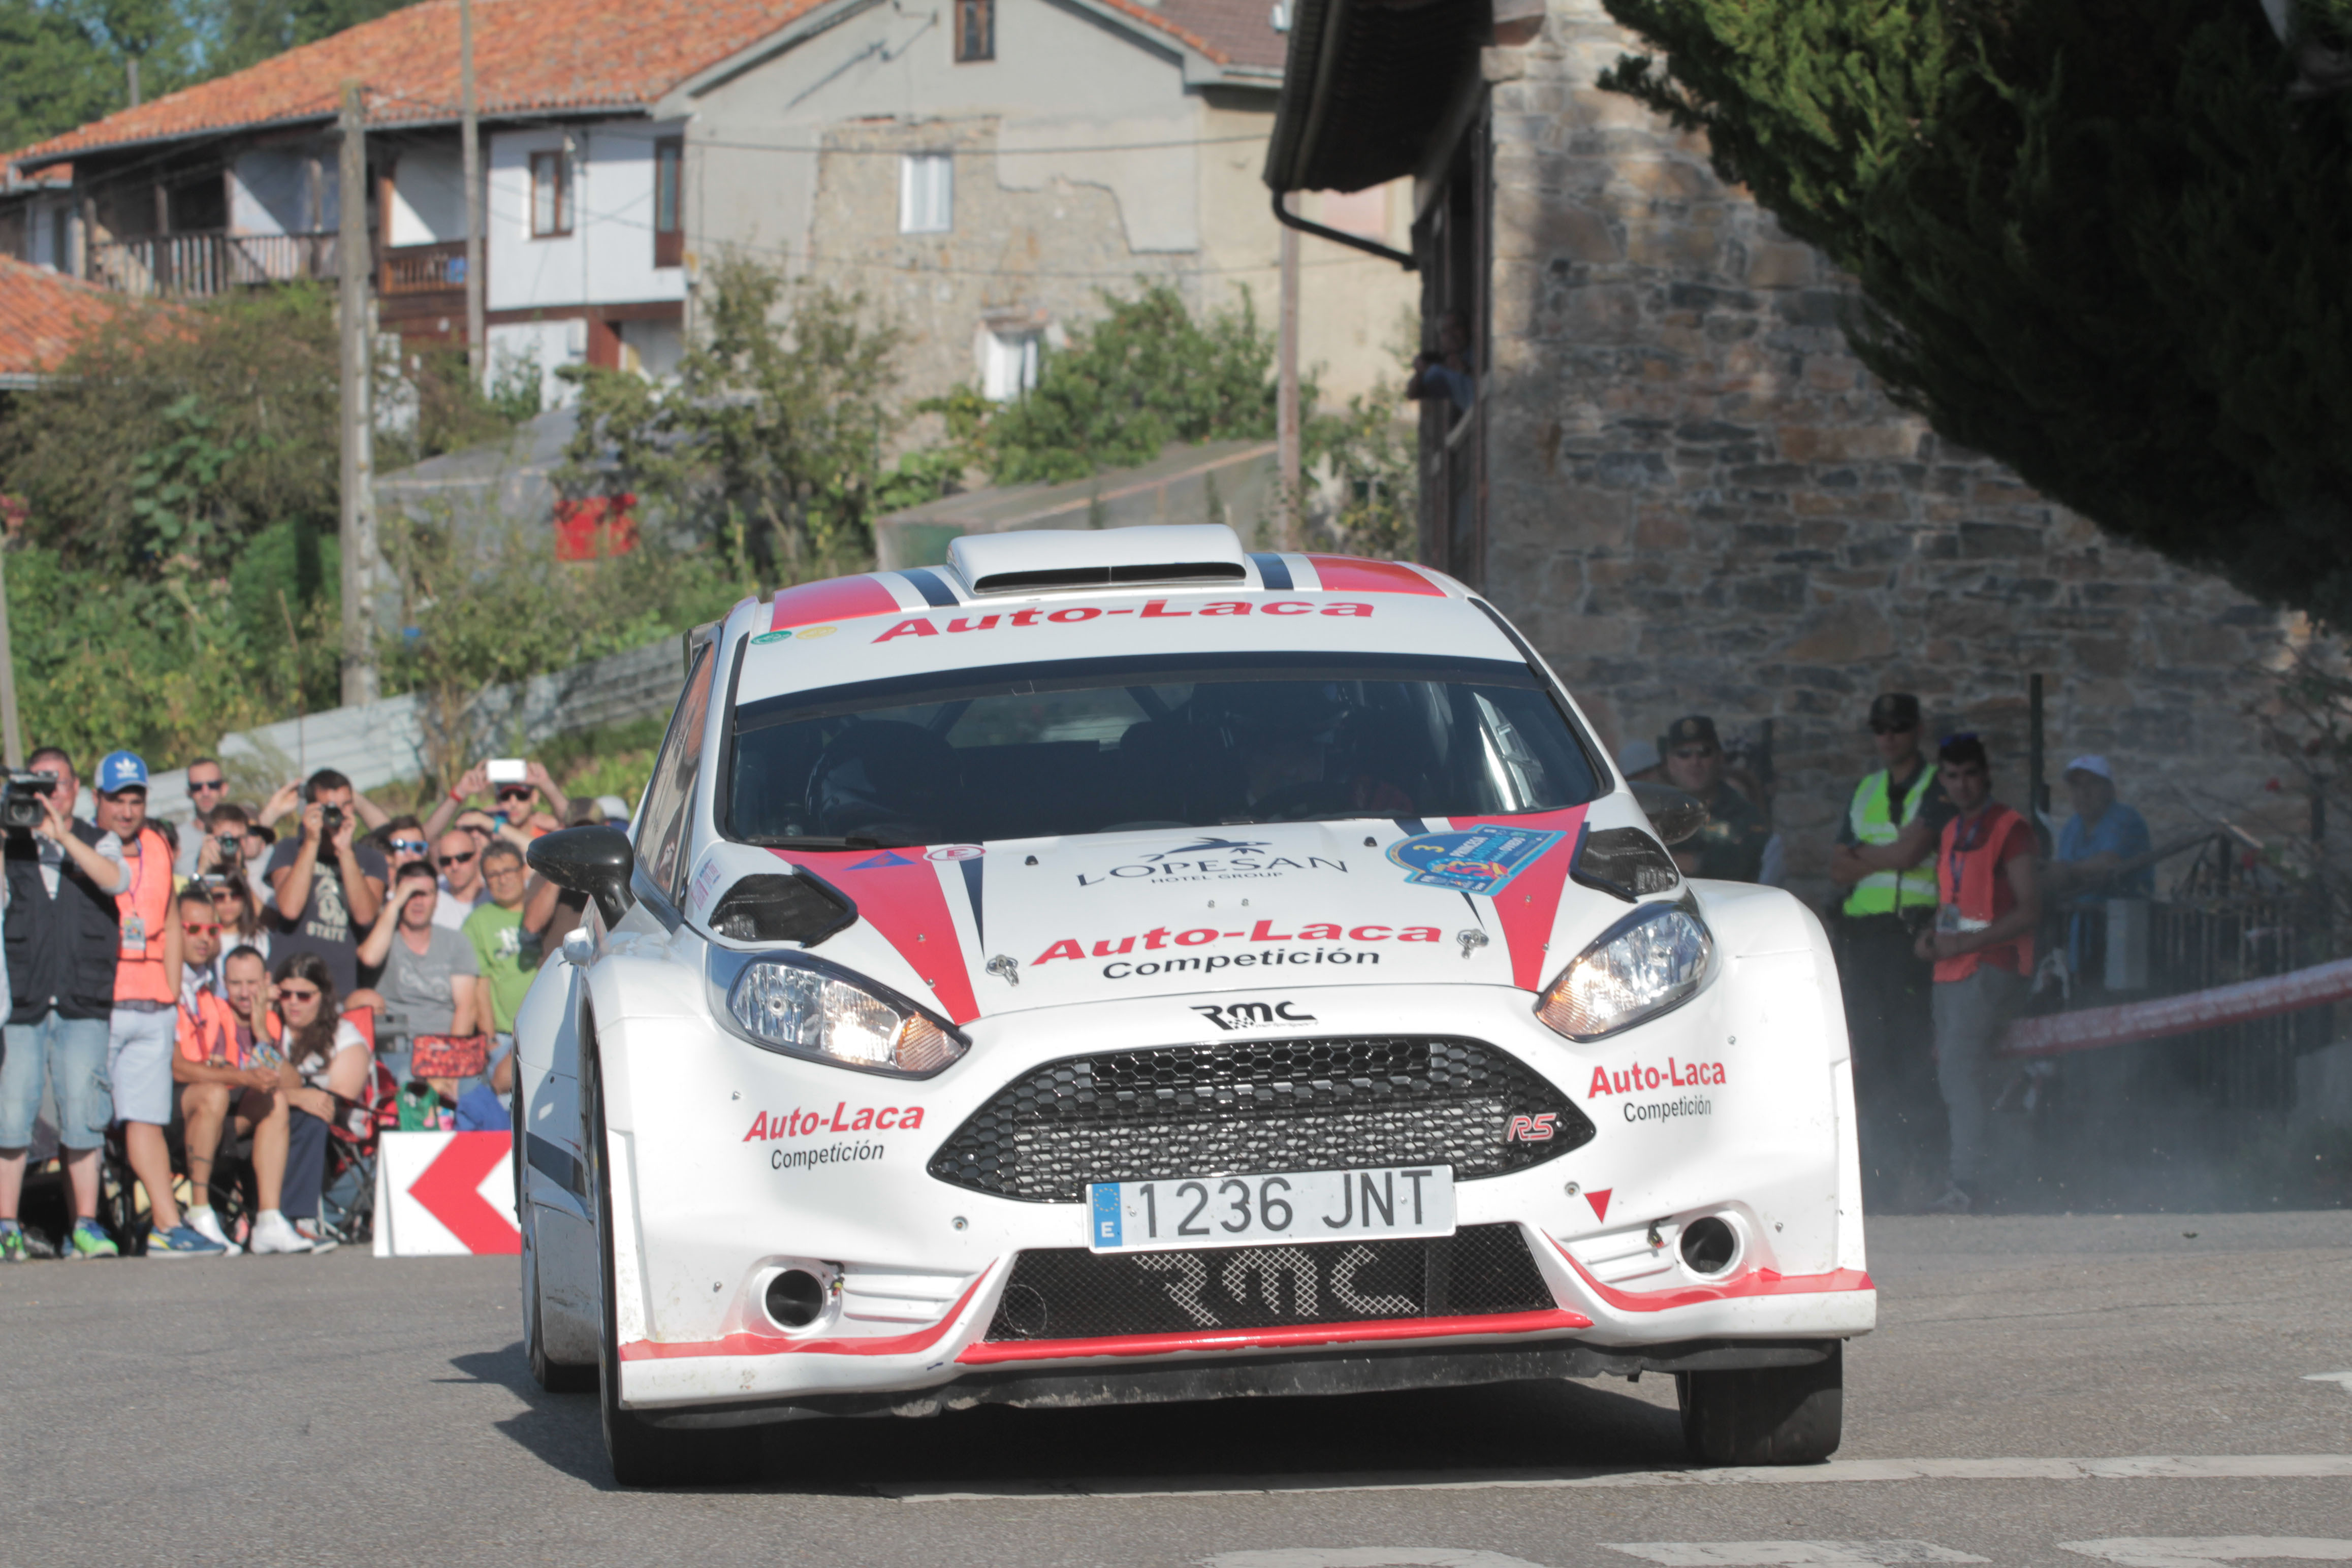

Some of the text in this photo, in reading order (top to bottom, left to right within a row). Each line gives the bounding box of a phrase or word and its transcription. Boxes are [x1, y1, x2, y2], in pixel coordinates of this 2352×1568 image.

[870, 598, 1374, 644] Auto-Laca
[1413, 845, 1445, 853] 3
[1076, 856, 1348, 887] LOPESAN
[1151, 875, 1212, 884] HOTEL
[1030, 919, 1442, 967] Auto-Laca
[1102, 947, 1380, 979] Competición
[1588, 1057, 1727, 1099] Auto-Laca
[742, 1102, 925, 1142] Auto-Laca
[1624, 1095, 1711, 1123] Competición
[771, 1139, 884, 1170] Competición
[1139, 1170, 1433, 1238] 1236 JNT
[1101, 1221, 1115, 1238] E
